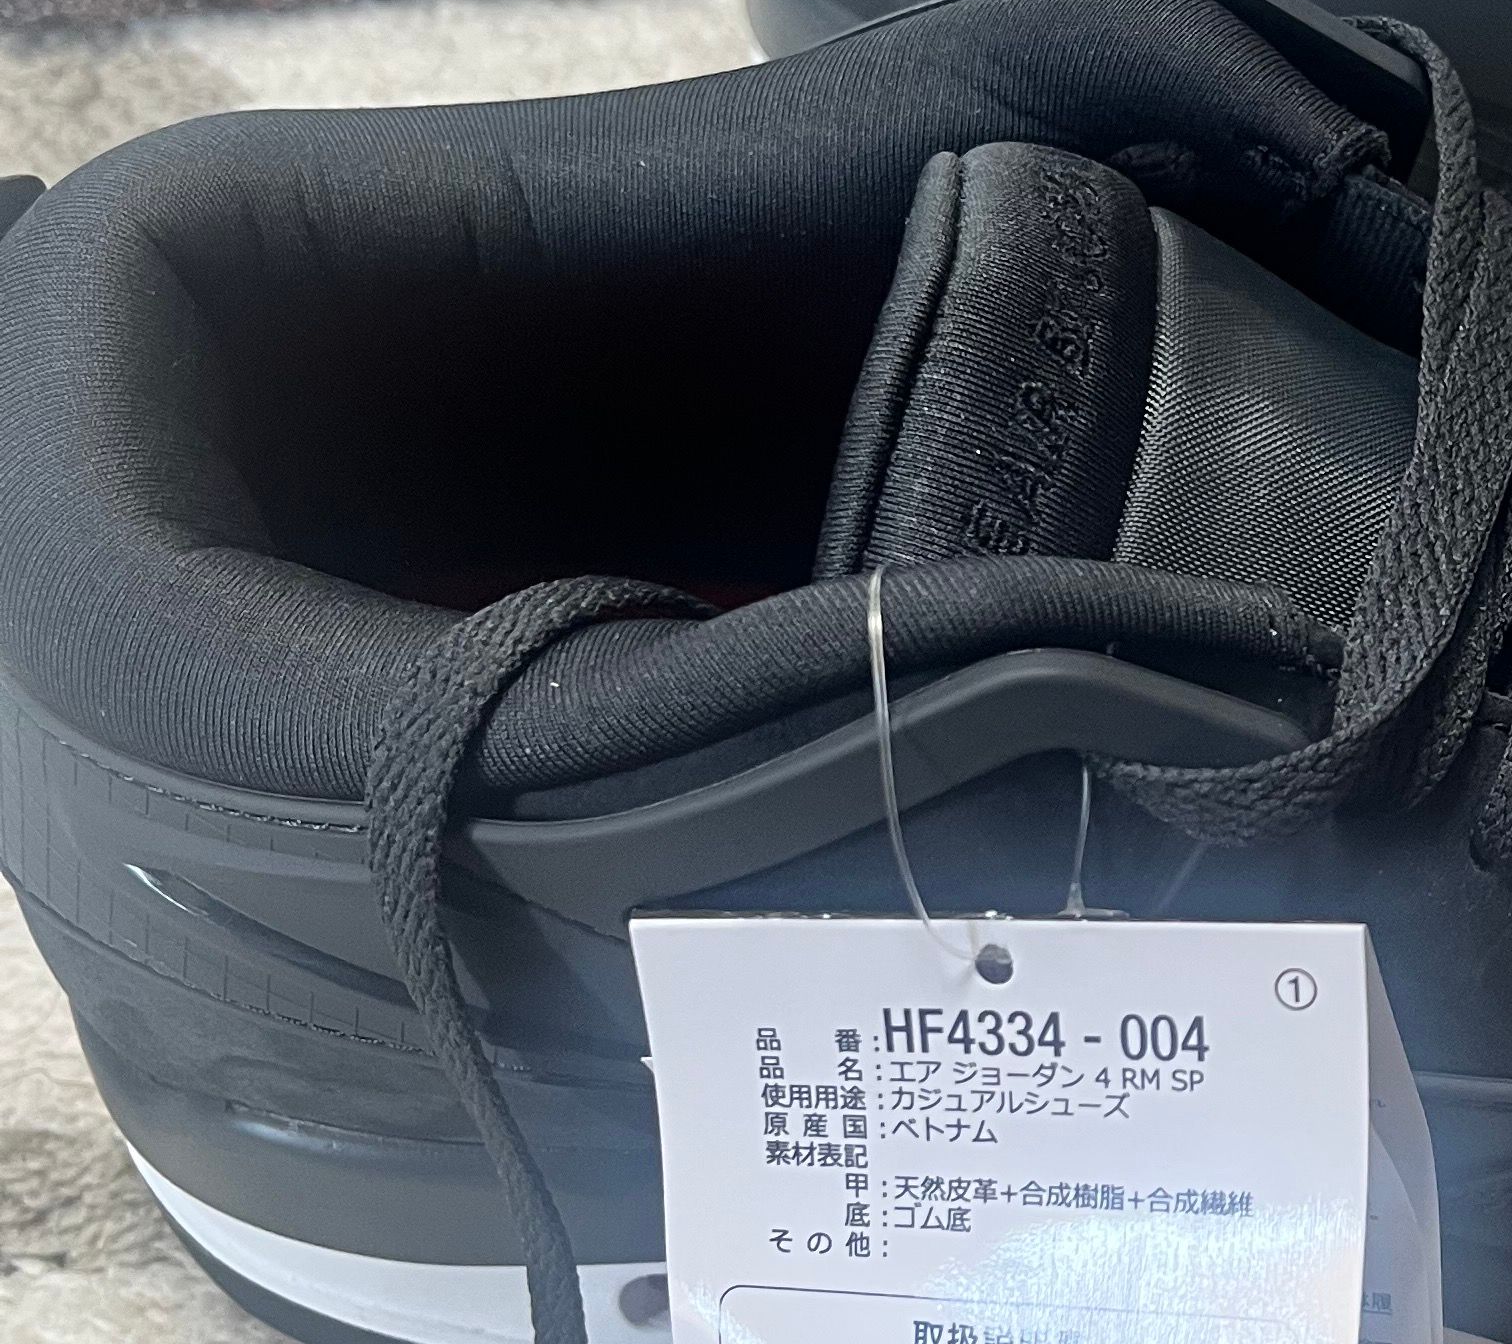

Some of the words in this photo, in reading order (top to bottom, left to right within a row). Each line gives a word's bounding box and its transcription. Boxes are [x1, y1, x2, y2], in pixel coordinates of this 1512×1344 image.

[1095, 1067, 1112, 1090] 4
[1121, 1067, 1161, 1091] RM
[1171, 1069, 1205, 1092] SP
[892, 1116, 999, 1144] ベトナム
[766, 1140, 868, 1169] 素材表記
[894, 1201, 972, 1233] ゴム底
